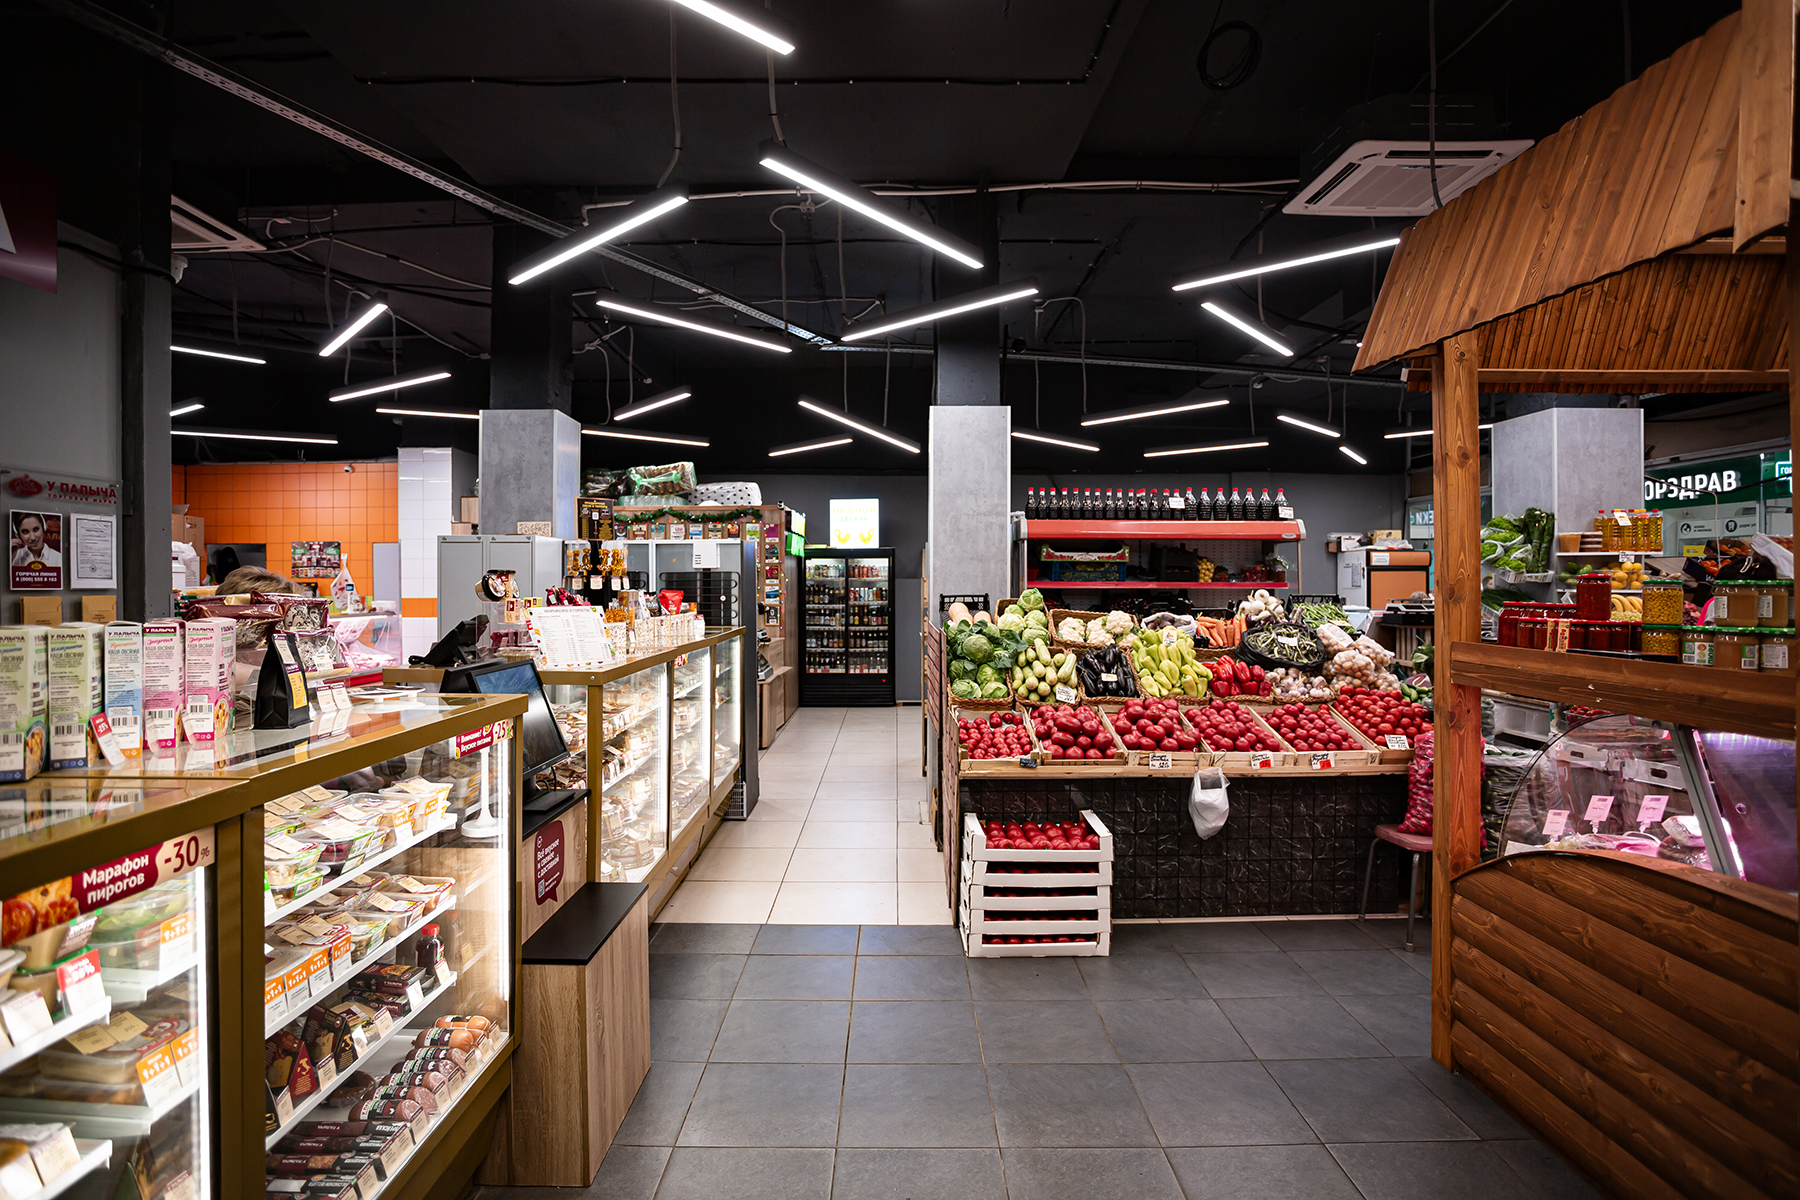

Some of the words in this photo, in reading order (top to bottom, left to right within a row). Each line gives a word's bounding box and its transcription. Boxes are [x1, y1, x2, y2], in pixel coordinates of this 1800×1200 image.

[46, 480, 56, 491] У
[60, 482, 117, 499] ПАЛЫЧА
[1644, 470, 1737, 500] ОРЗДРАВ
[47, 493, 89, 502] ТОРГОВАЯ
[82, 854, 149, 889] Марафон
[87, 872, 145, 905] пирогов
[163, 920, 192, 942] 1+1+1
[334, 942, 350, 958] 1+1+1
[309, 956, 328, 972] 1+1+1
[288, 970, 307, 988] 1+1+1
[265, 984, 283, 1002] +1+1
[141, 1055, 171, 1080] 1+1+1
